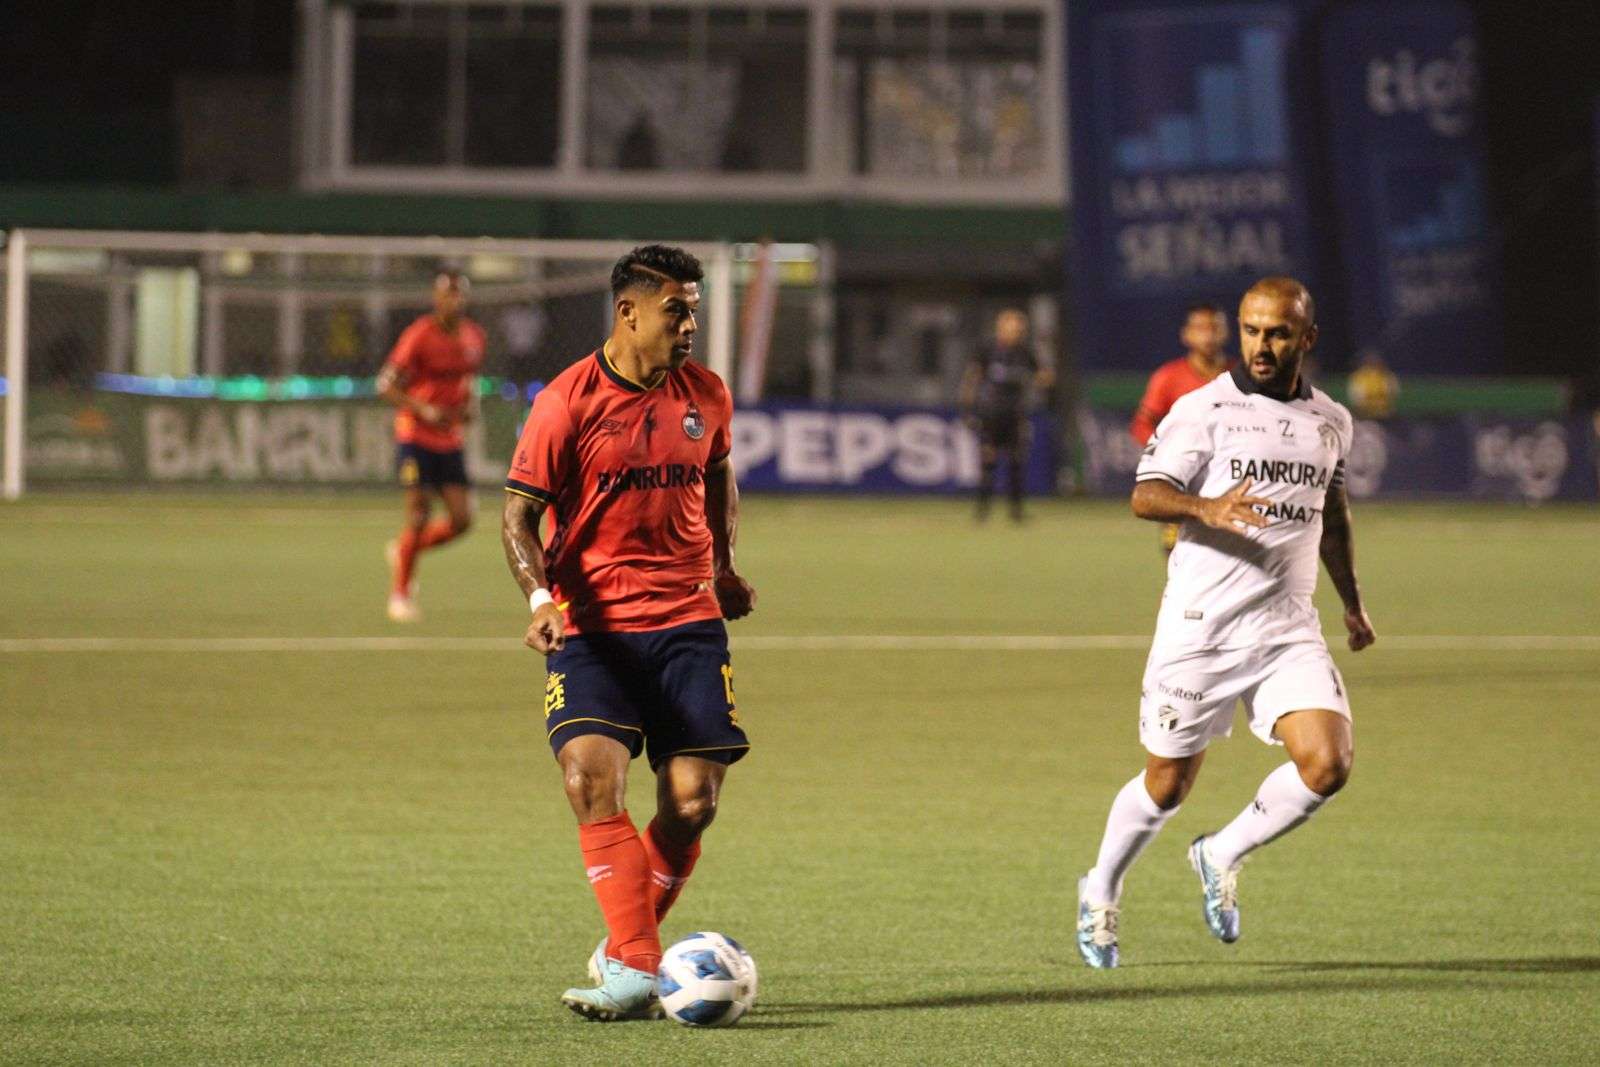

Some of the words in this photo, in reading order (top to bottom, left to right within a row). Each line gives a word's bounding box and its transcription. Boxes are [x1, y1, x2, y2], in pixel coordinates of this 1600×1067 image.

[733, 410, 981, 487] PEPSI
[598, 463, 703, 493] BANRURA
[1230, 458, 1329, 490] BANRURA
